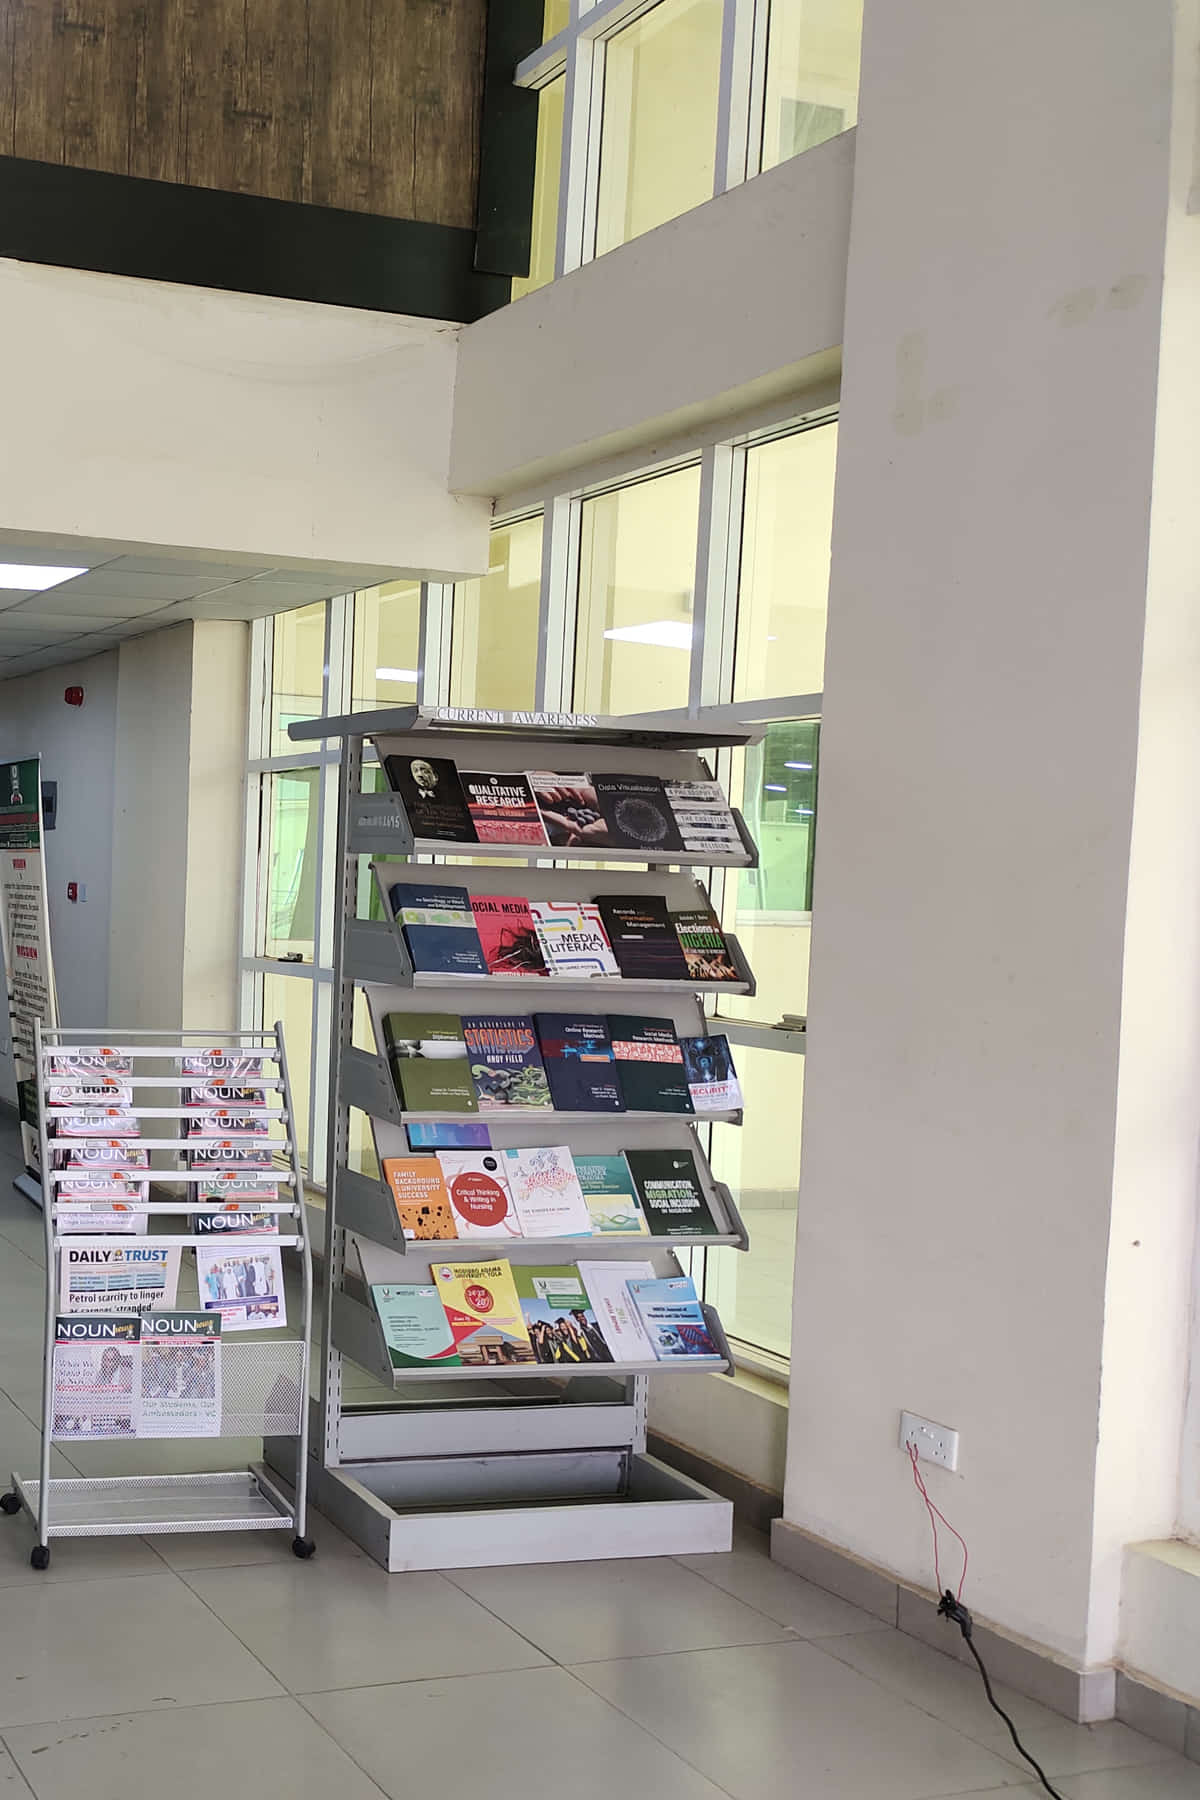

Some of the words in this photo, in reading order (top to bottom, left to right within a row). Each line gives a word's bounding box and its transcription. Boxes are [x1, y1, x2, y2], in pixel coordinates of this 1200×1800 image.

[438, 707, 504, 722] CURRENT
[514, 712, 598, 726] AWARENESS
[469, 784, 527, 797] QUALITATIVE
[598, 783, 617, 792] Data
[475, 796, 526, 808] RESEARCH
[472, 902, 500, 913] OCIAL
[501, 903, 529, 914] MEDIA
[675, 923, 713, 934] Elections
[561, 933, 601, 944] MEDIA
[680, 933, 725, 949] NIGERIA
[550, 943, 605, 953] LITERACY
[464, 1028, 535, 1047] STATISTICS
[486, 1055, 504, 1064] ANDY
[505, 1054, 524, 1064] FIELD
[191, 1087, 244, 1099] NOUN
[61, 1117, 115, 1127] NOUN
[191, 1118, 245, 1128] NOUN
[71, 1149, 127, 1160] NOUN
[194, 1149, 248, 1159] NOUN
[456, 1188, 477, 1196] Critical
[477, 1189, 500, 1197] Thinking
[470, 1203, 493, 1211] Nursing
[198, 1213, 253, 1231] NOUN
[69, 1250, 111, 1263] DAILY
[125, 1249, 168, 1261] TRUST
[69, 1293, 96, 1303] Petrol
[98, 1292, 127, 1303] scarcity
[130, 1292, 138, 1300] to
[140, 1290, 163, 1301] linger
[57, 1323, 116, 1337] NOUN
[141, 1319, 197, 1333] NOUN
